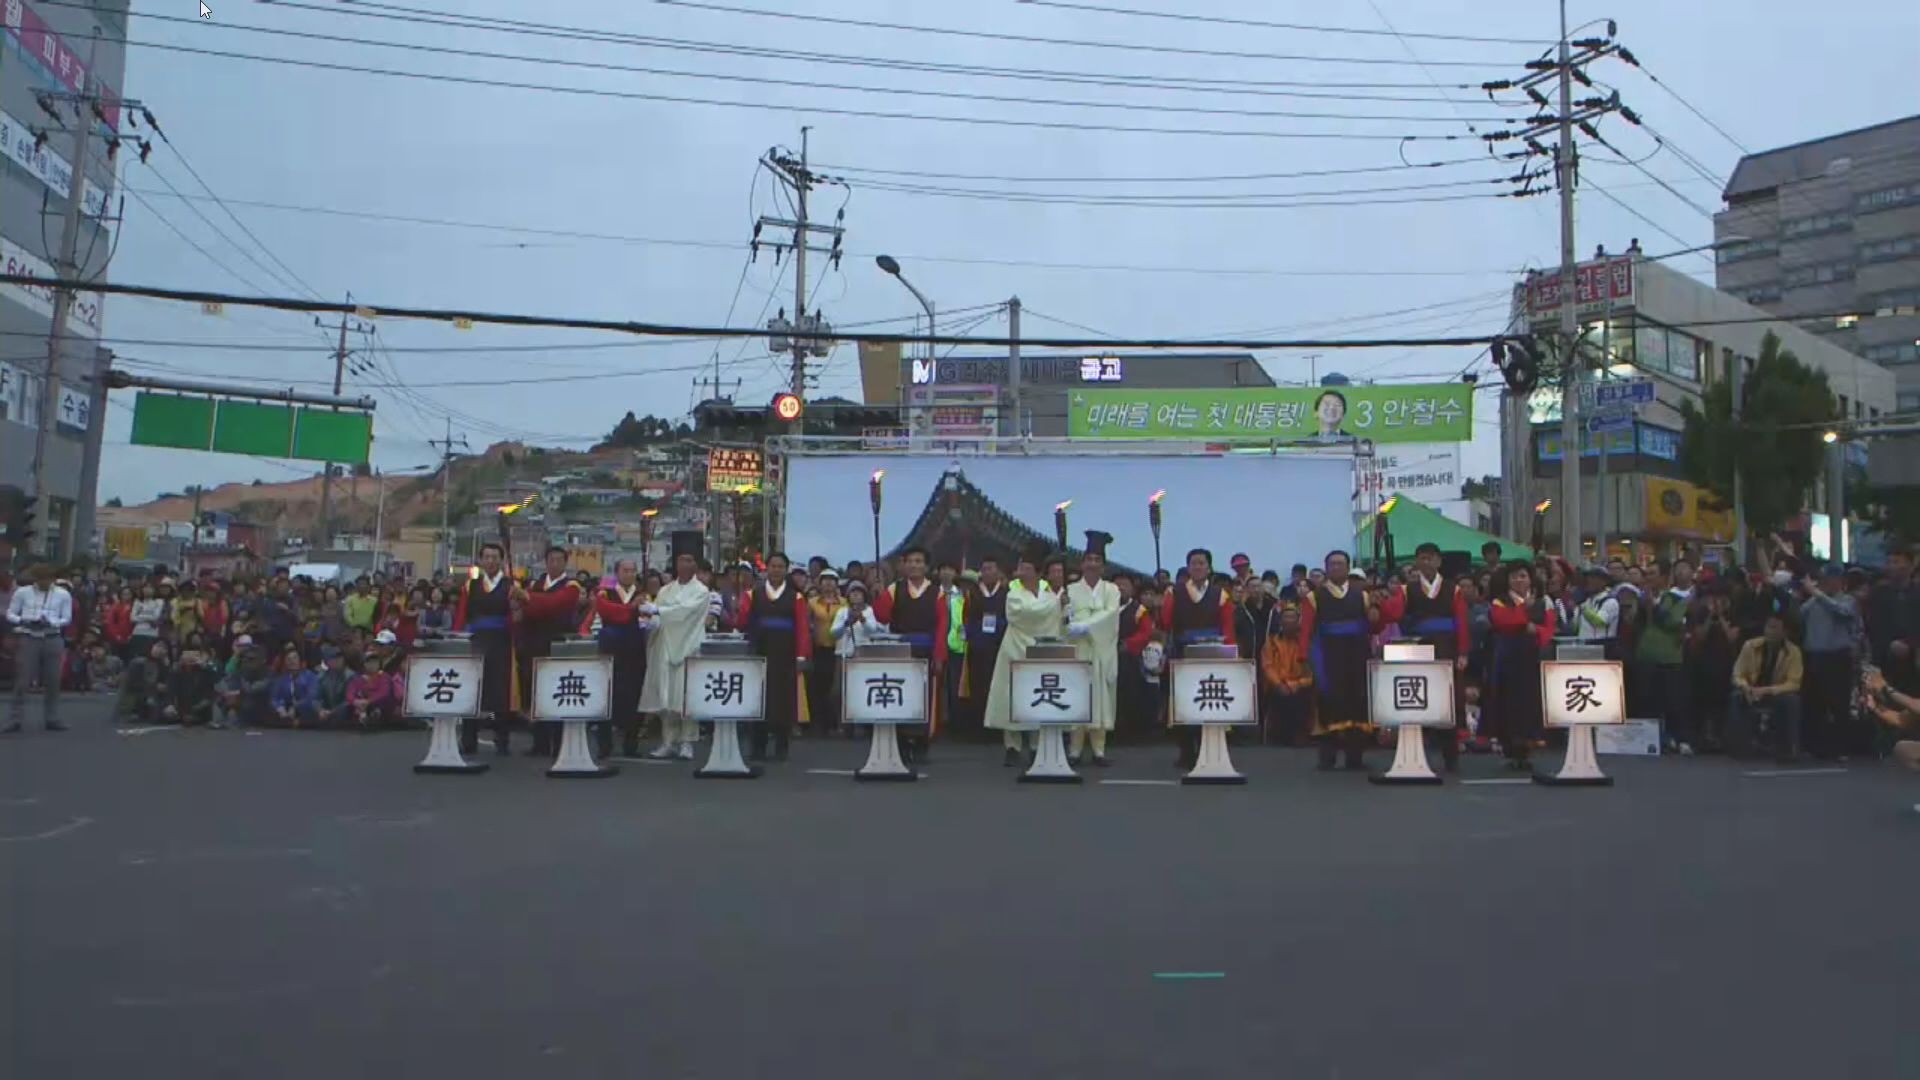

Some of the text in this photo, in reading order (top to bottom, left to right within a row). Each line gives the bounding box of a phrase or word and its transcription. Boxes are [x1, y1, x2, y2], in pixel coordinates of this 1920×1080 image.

[63, 394, 88, 424] 수술
[1087, 398, 1465, 430] 미래를 여는 첫 대통령! 3 안철수
[424, 669, 461, 703] 若
[553, 671, 590, 706] 無
[705, 671, 743, 705] 湖
[866, 673, 905, 708] 南
[1031, 674, 1070, 710] 是
[1194, 674, 1234, 710] 無
[1394, 676, 1428, 710] 國
[1566, 676, 1601, 712] 家
